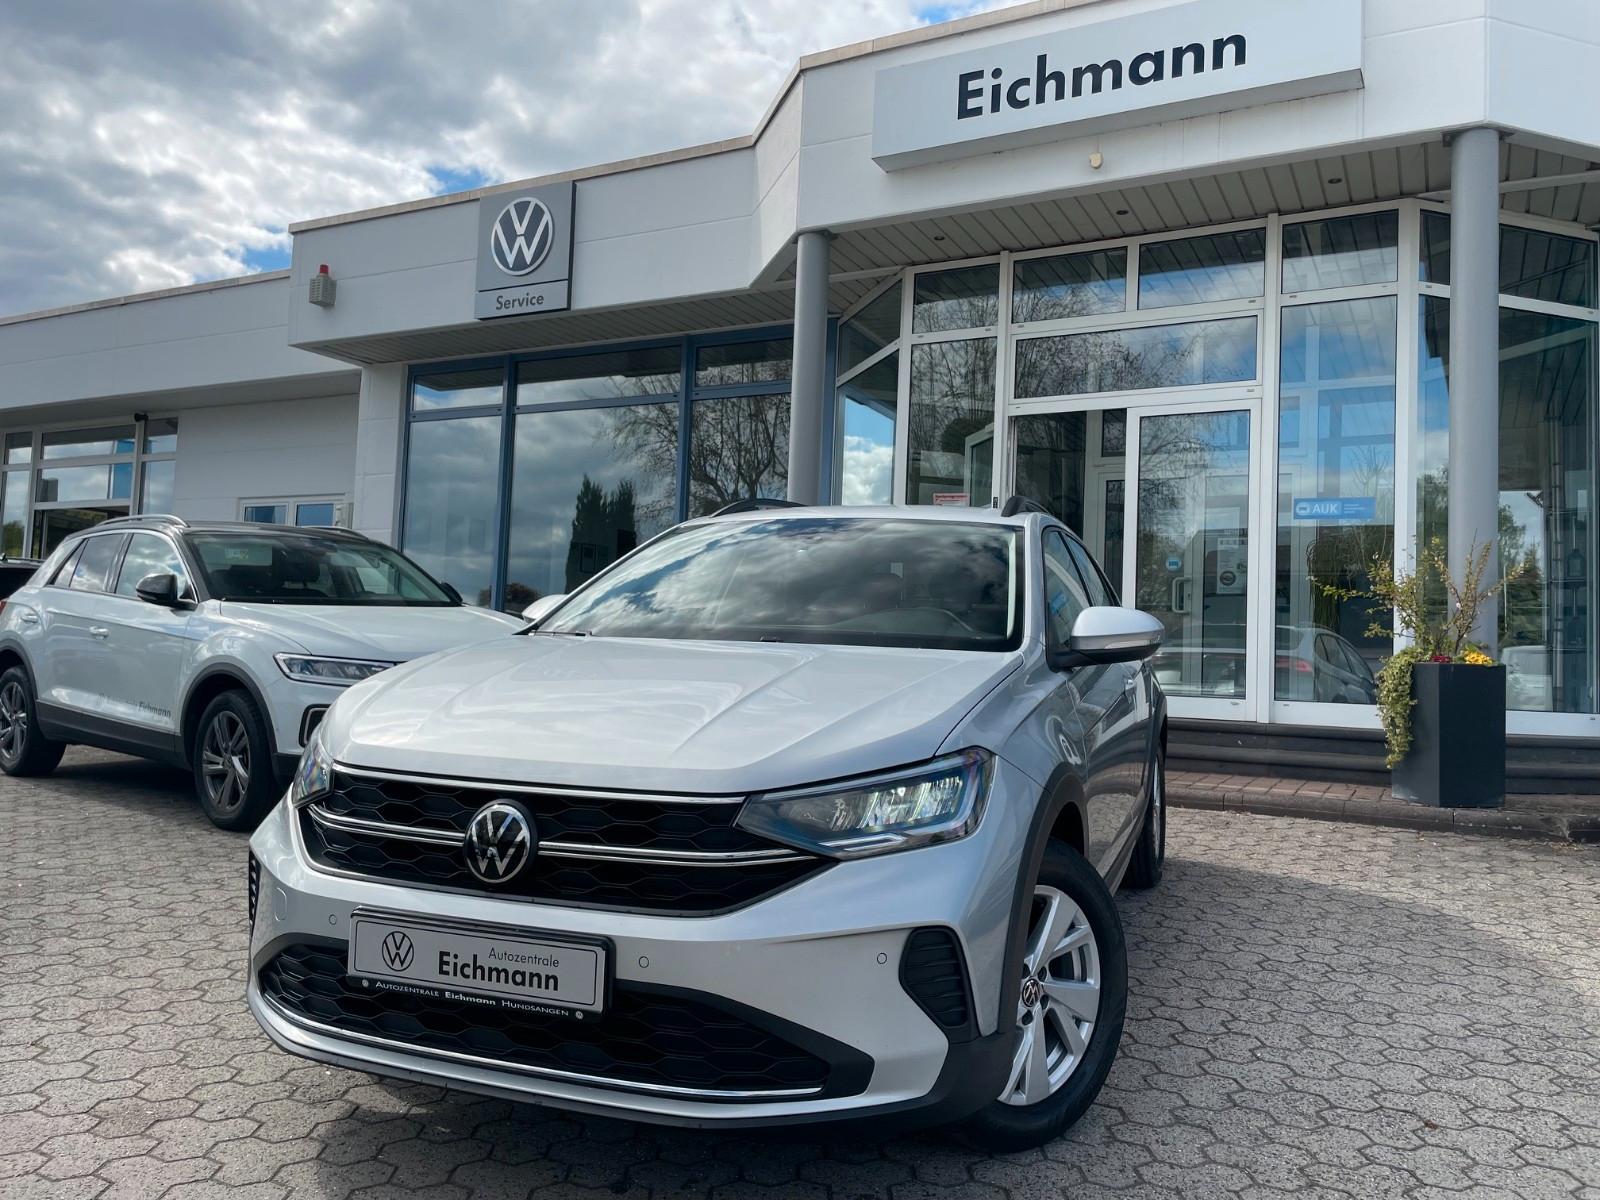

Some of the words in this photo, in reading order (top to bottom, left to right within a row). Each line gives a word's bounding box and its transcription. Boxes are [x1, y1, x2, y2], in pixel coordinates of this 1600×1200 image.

[957, 34, 1247, 120] Eichmann
[491, 197, 554, 276] VW
[496, 293, 544, 310] Service
[1312, 503, 1338, 514] AUK
[466, 804, 530, 883] VW
[382, 931, 414, 972] VW
[438, 950, 559, 991] Eichmann
[488, 947, 560, 968] Autozentrale
[444, 991, 496, 1006] Eichmann
[501, 1000, 569, 1016] HUNDSANGEN
